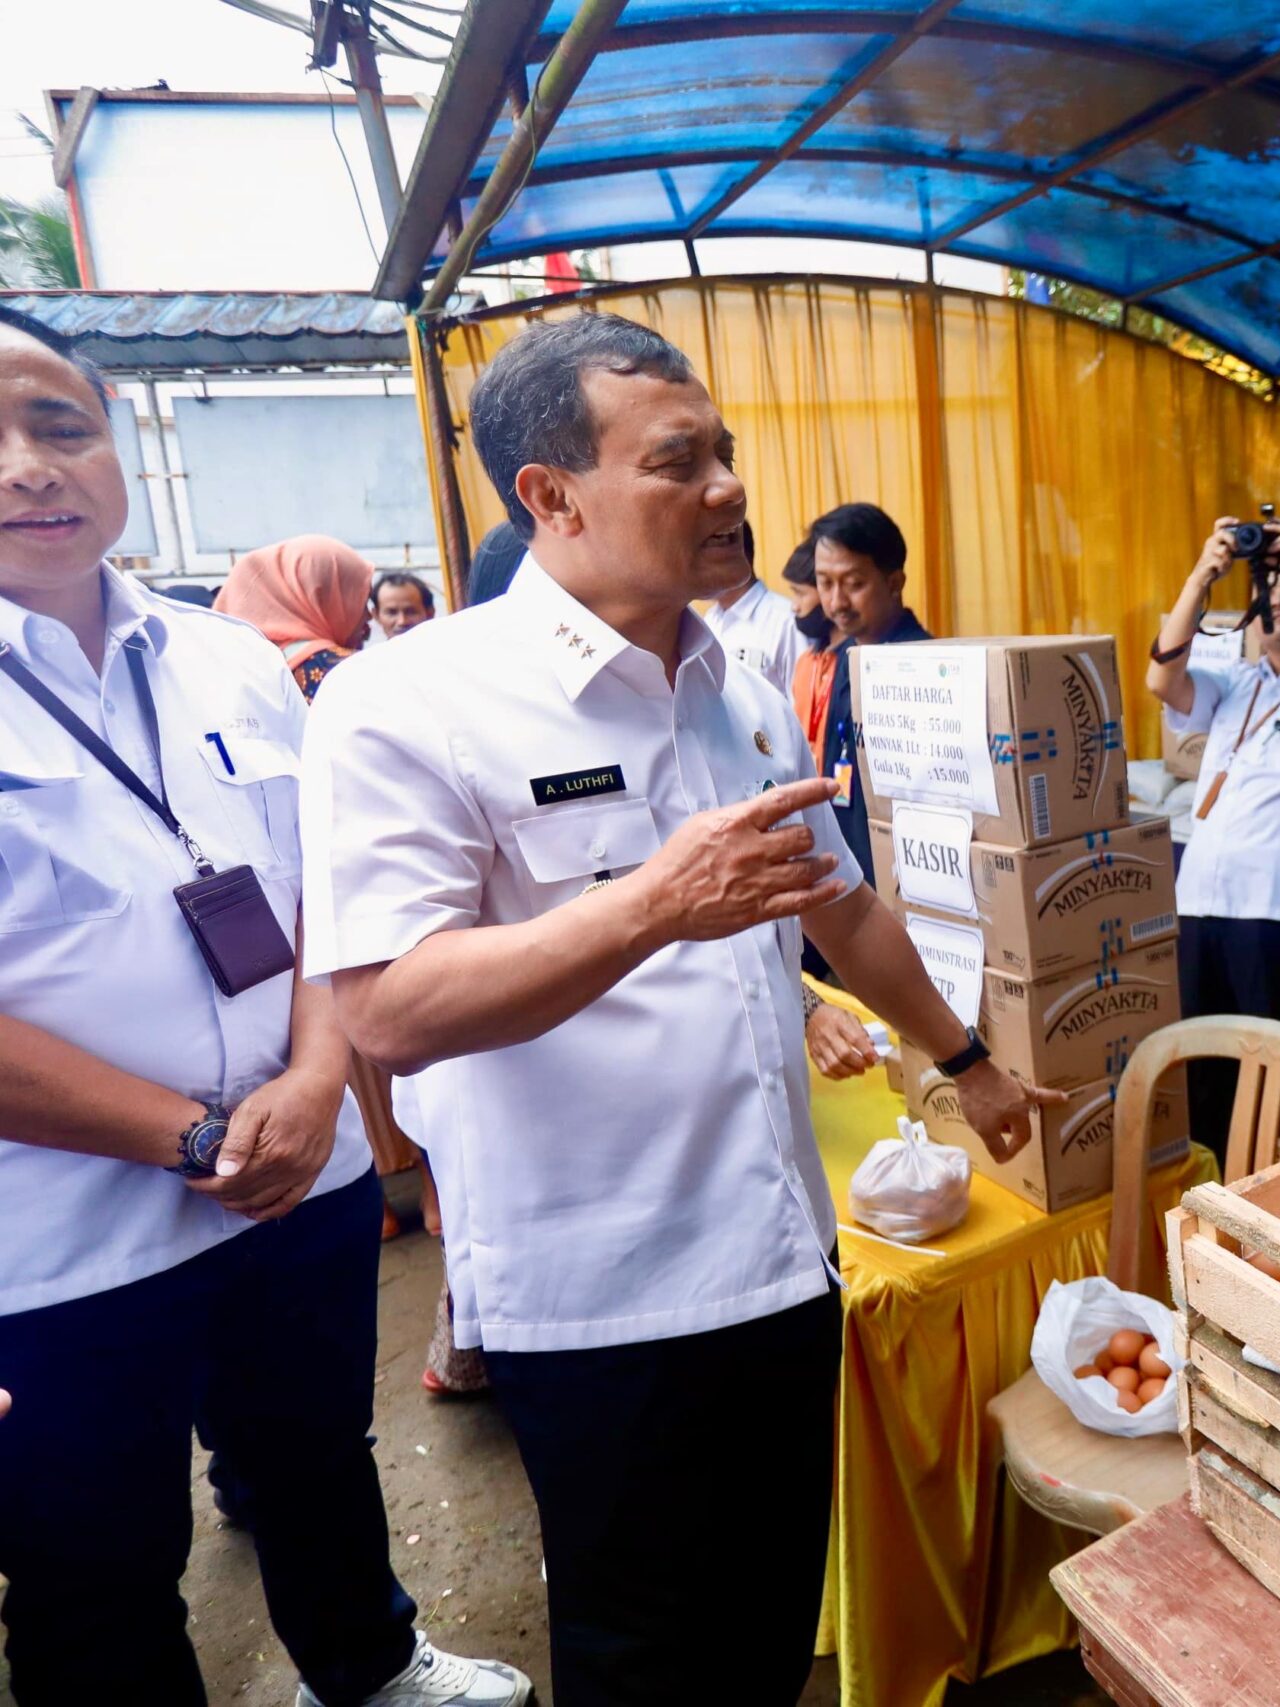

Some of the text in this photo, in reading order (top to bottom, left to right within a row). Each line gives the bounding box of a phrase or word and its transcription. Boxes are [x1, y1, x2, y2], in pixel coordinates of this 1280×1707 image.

[872, 684, 953, 705] DAFTAR HARGA
[868, 712, 896, 728] BERAS
[897, 714, 916, 733] 5Kg
[928, 717, 961, 735] 55.000
[1062, 672, 1095, 801] MINYAKITA
[869, 735, 904, 754] MINYAK
[930, 743, 963, 761] 14.000
[565, 773, 614, 792] LUTHFI
[874, 758, 893, 774] Gula
[894, 762, 911, 781] 1Kg
[934, 767, 970, 785] 15.000
[902, 837, 964, 879] KASIR
[1053, 867, 1153, 918] MINYAKITA
[1061, 990, 1159, 1040] MINYAKITA
